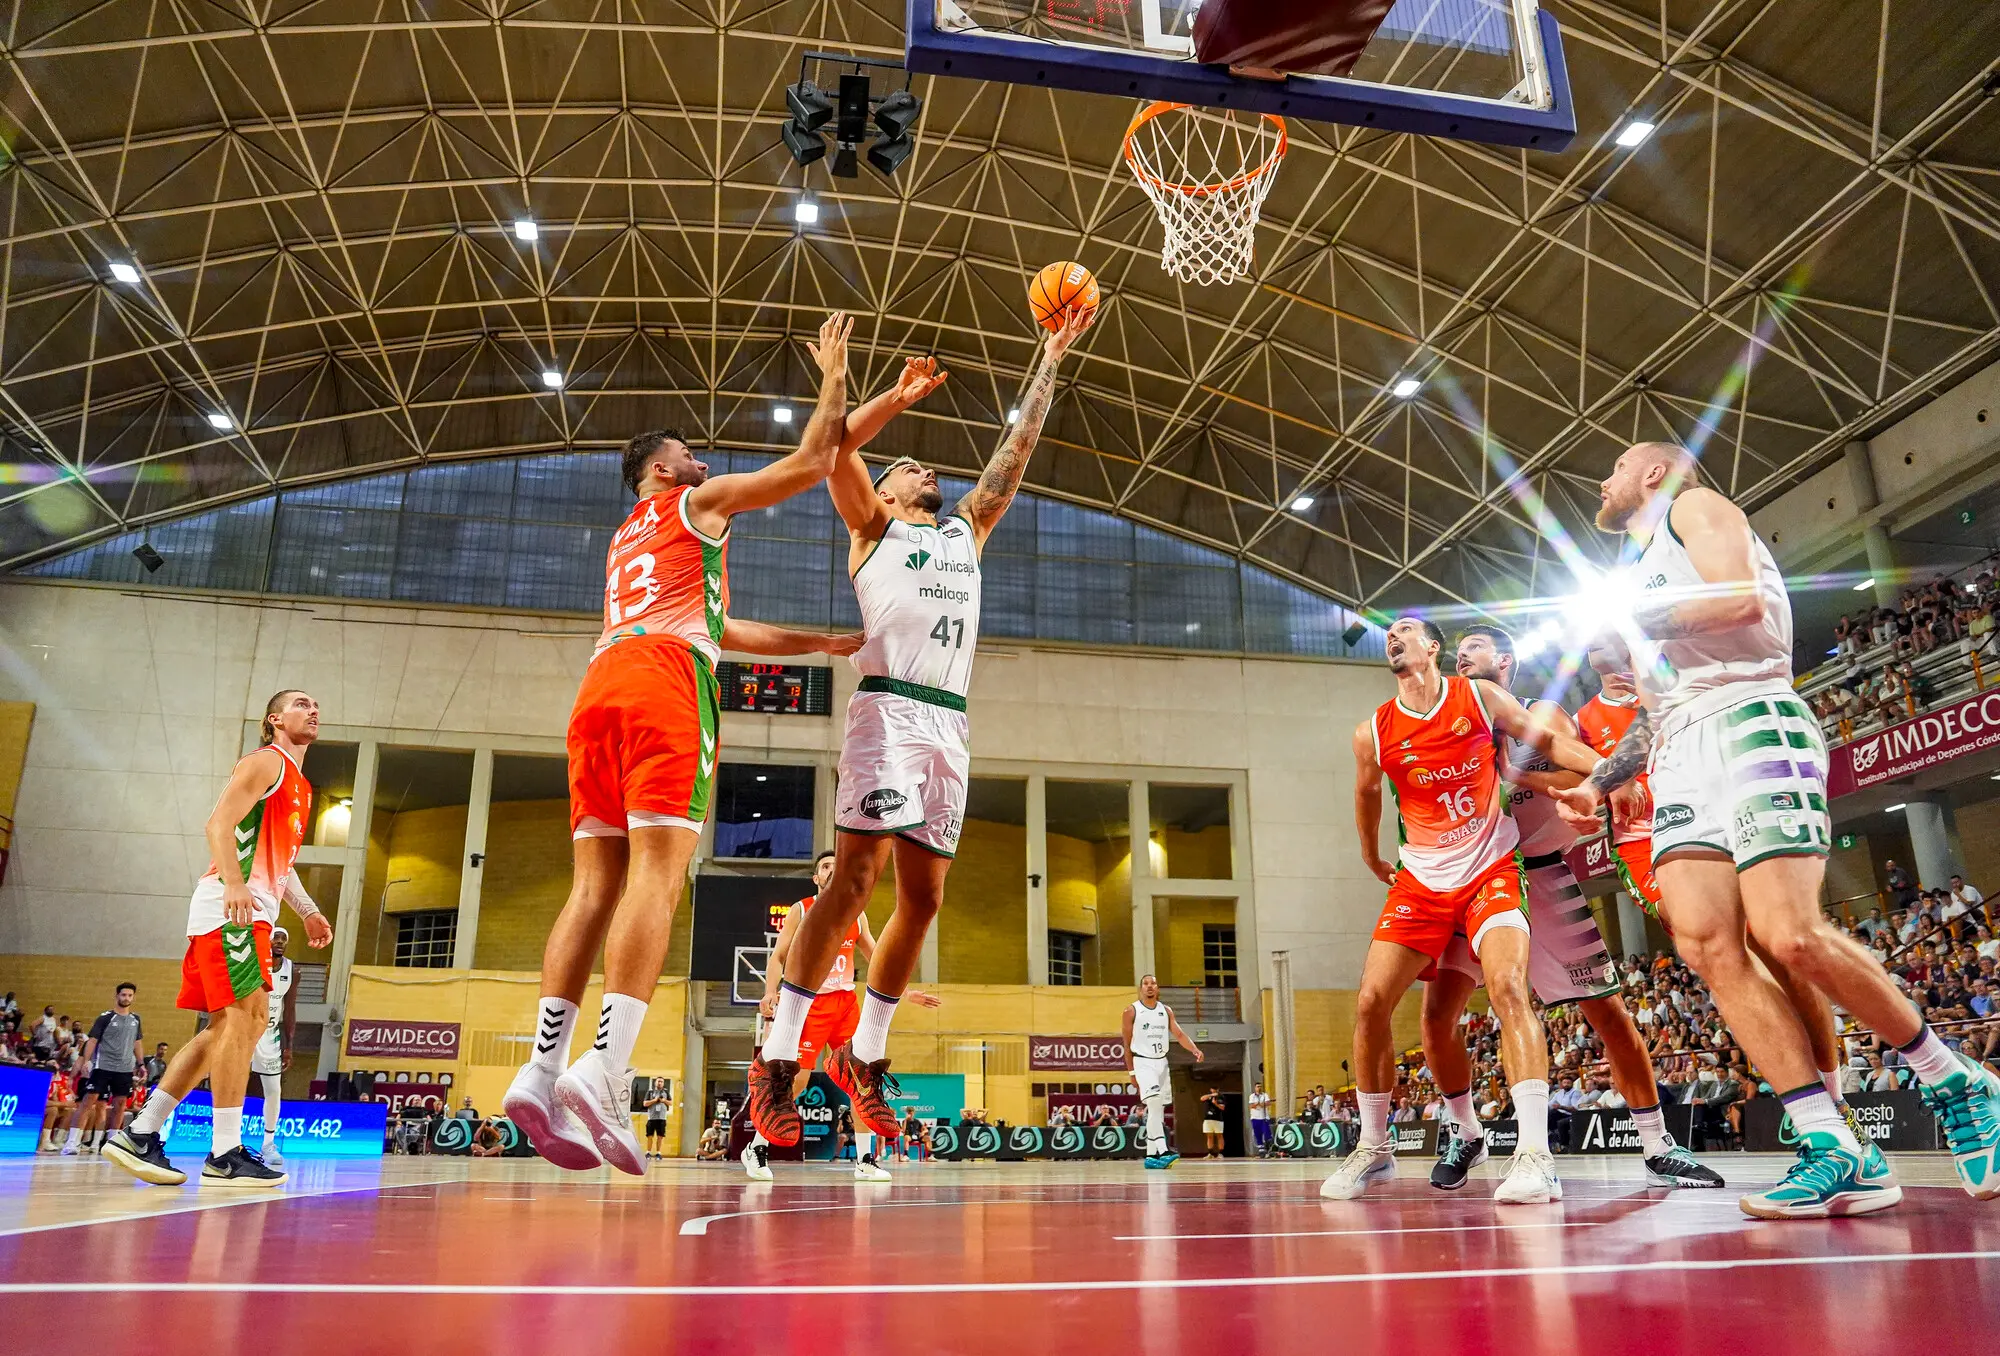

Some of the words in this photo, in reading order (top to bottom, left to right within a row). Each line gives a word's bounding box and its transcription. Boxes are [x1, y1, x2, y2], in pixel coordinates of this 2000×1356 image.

[605, 552, 661, 626] 13
[930, 615, 964, 649] 41
[743, 683, 758, 694] 27
[1883, 694, 2000, 761] IMDECO
[1417, 757, 1481, 785] INSOLAC
[1857, 771, 1887, 787] Instituto
[1887, 757, 1924, 776] Municipal
[1926, 755, 1937, 764] de
[1937, 742, 1976, 760] Deportes
[1436, 786, 1476, 821] 16
[1654, 807, 1693, 827] adesa
[1842, 835, 1851, 848] B
[376, 1027, 456, 1046] IMDECO
[1054, 1044, 1124, 1059] IMDECO
[1152, 1042, 1163, 1053] 19
[308, 1119, 342, 1138] 482
[1609, 1133, 1621, 1147] de
